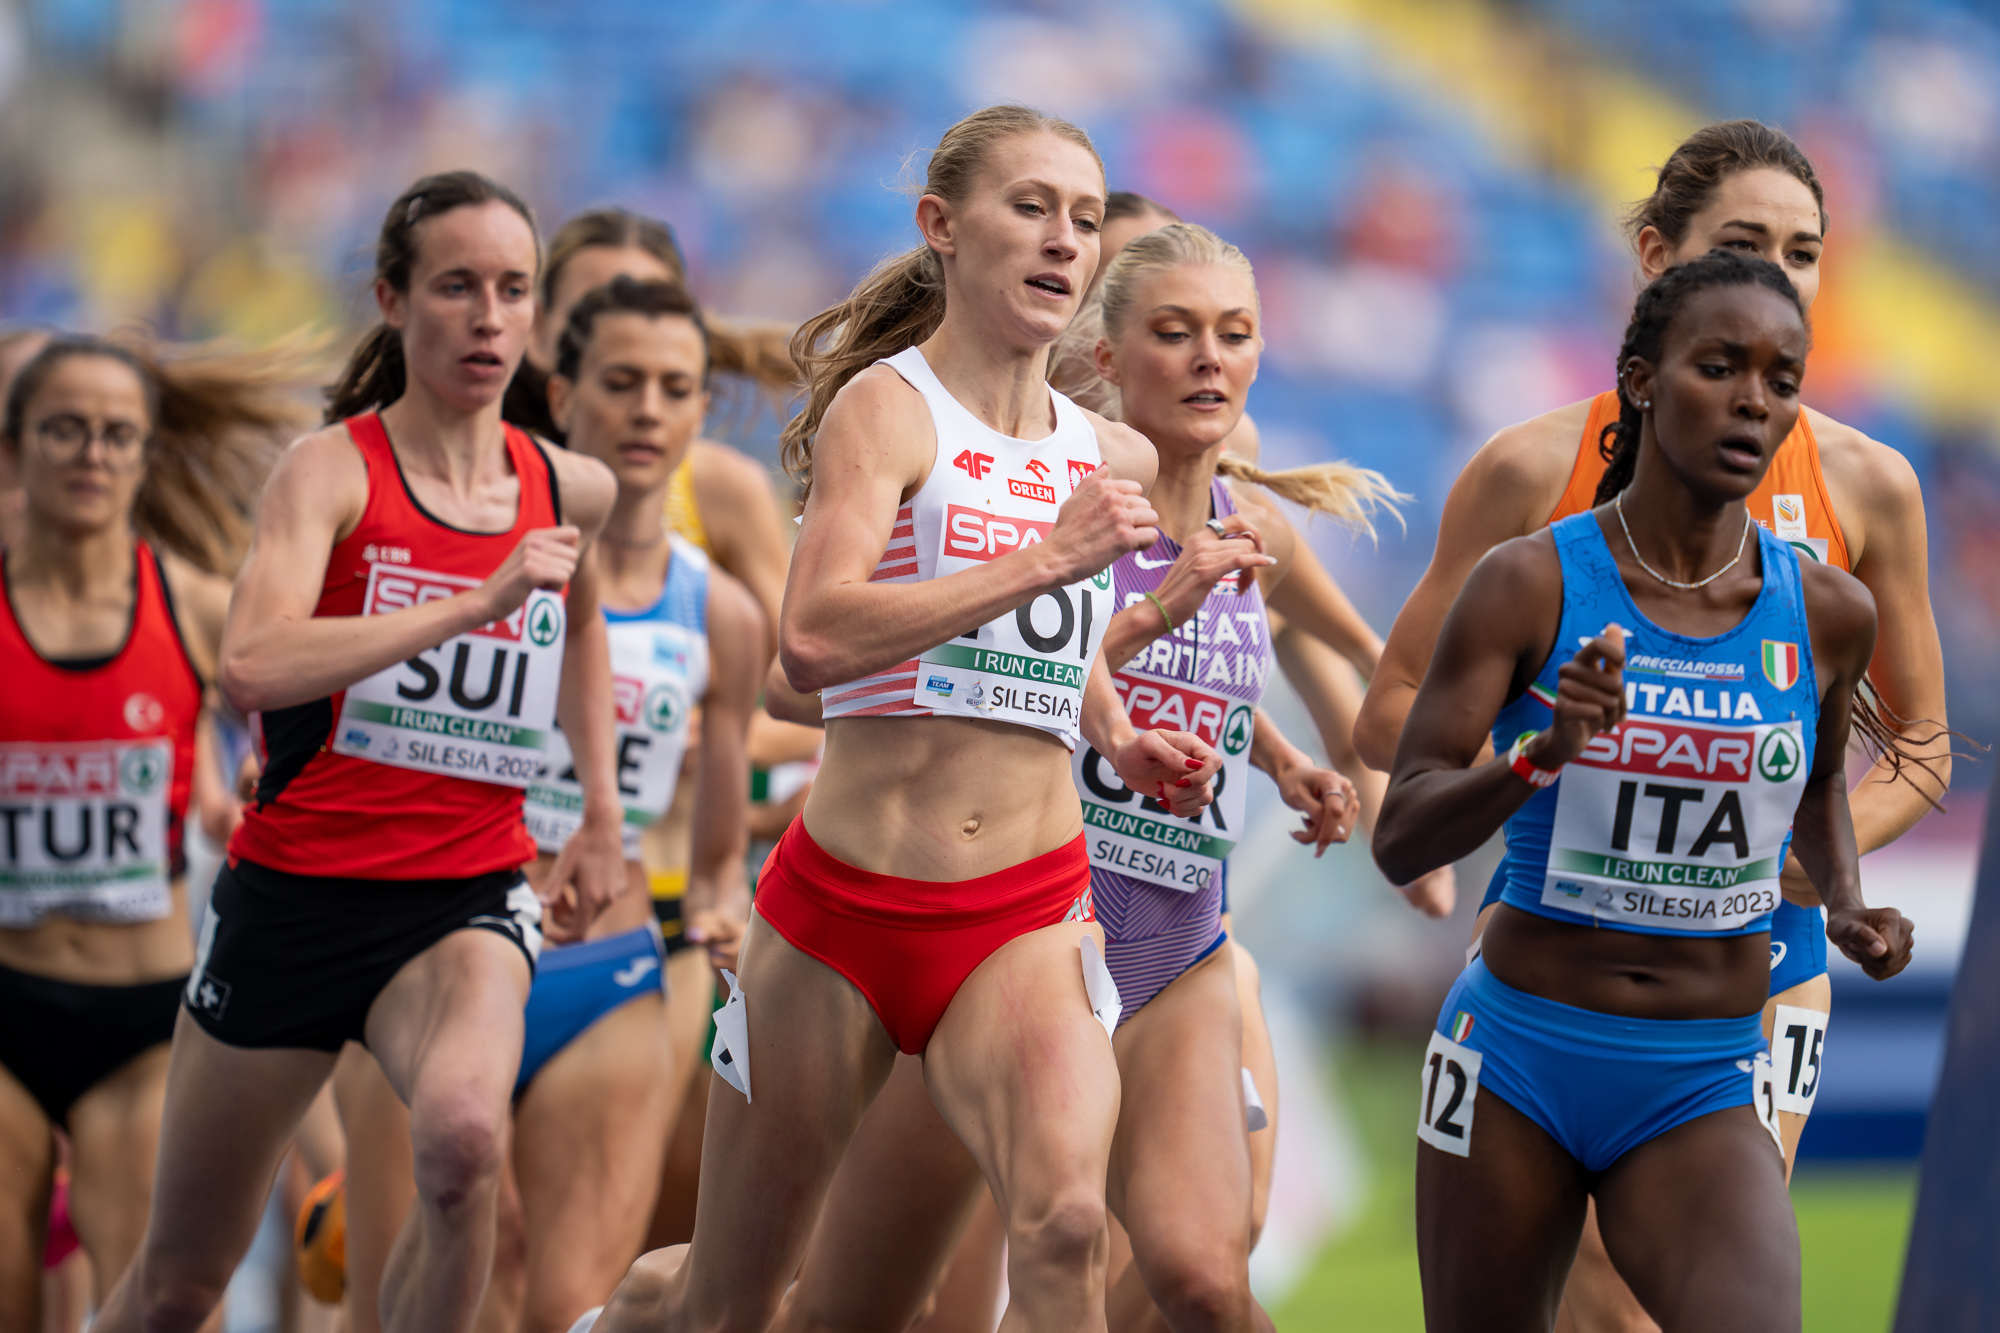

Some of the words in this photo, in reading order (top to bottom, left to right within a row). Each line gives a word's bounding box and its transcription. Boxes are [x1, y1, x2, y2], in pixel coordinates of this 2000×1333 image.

[953, 449, 994, 481] 4F
[1011, 481, 1053, 502] ORLEN
[951, 512, 1044, 555] SPA
[380, 546, 411, 564] UBS
[397, 643, 528, 718] SUI
[974, 651, 981, 668] I
[985, 653, 1025, 676] RUN
[1628, 654, 1745, 676] FRECCIAROSSA
[932, 680, 950, 689] TEAM
[1626, 681, 1763, 721] ITALIA
[991, 686, 1072, 719] SILESIA
[391, 708, 399, 724] I
[400, 710, 447, 733] RUN
[449, 716, 513, 743] CLEAN
[407, 740, 489, 773] SILESIA
[0, 803, 140, 864] TUR
[1084, 804, 1091, 820] I
[1093, 807, 1139, 834] RUN
[1140, 823, 1201, 851] CLEAN
[1611, 780, 1750, 860] ITA
[1094, 840, 1176, 880] SILESIA
[1603, 858, 1611, 875] I
[1615, 860, 1663, 883] RUN
[1668, 865, 1739, 886] CLEAN
[1623, 891, 1716, 918] SILESIA
[1722, 890, 1775, 917] 2023
[1785, 1024, 1823, 1098] 15
[1425, 1051, 1467, 1140] 12
